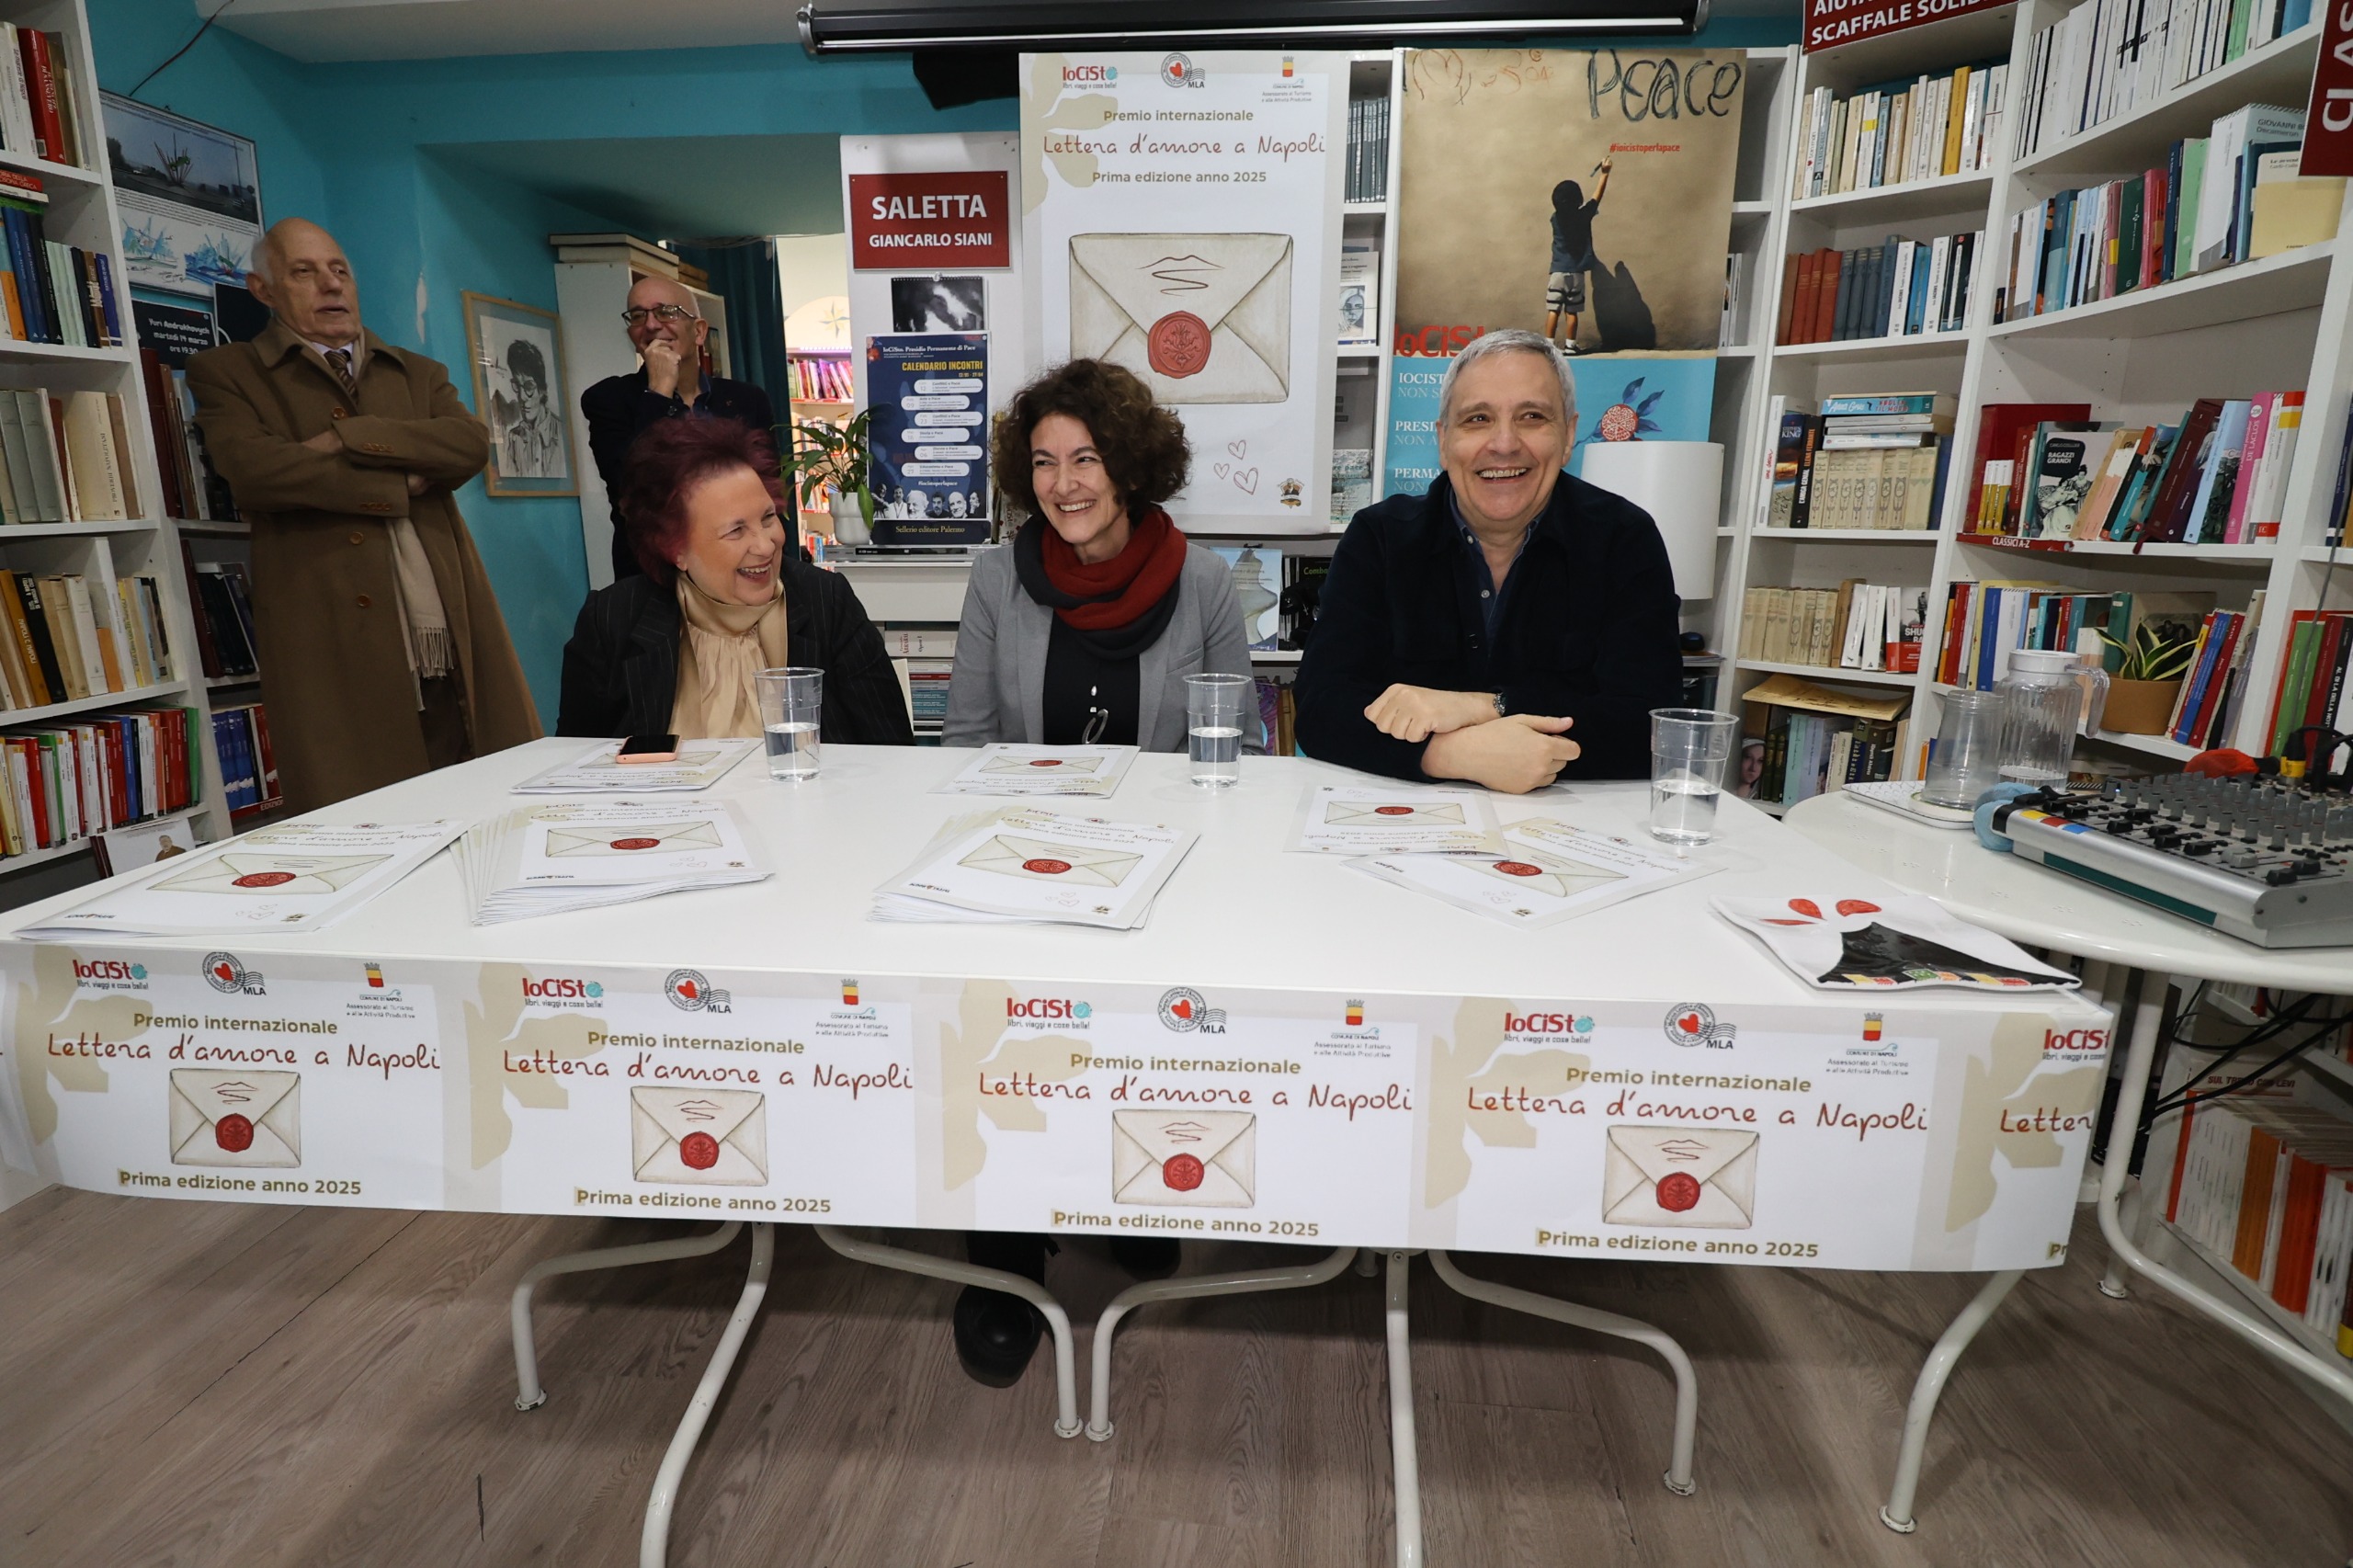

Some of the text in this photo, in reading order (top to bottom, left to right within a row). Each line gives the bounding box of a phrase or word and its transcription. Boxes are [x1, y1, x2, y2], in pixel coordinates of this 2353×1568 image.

[1811, 8, 1911, 45] SCAFFALE
[1586, 50, 1741, 121] Peace
[1104, 110, 1253, 120] Premio internazionale
[1044, 133, 1324, 163] Lettera d'amore a Napoli
[1093, 172, 1266, 182] Prima edizione anno 2025
[872, 195, 987, 220] SALETTA
[870, 233, 992, 247] GIANCARLO SIANI
[902, 361, 983, 371] CALENDARIO INCONTRI
[1398, 387, 1427, 398] NON
[1781, 430, 1802, 438] KING
[1992, 537, 2029, 549] CLASSICI A-Z
[2328, 692, 2336, 711] DELLA
[244, 987, 266, 995] MLA
[708, 1005, 732, 1013] MLA
[134, 1014, 337, 1034] Premio internazionale
[1200, 1025, 1226, 1034] MLA
[588, 1032, 804, 1053] Premio internazionale
[1707, 1039, 1733, 1049] MLA
[49, 1032, 440, 1080] Lettera d'amore a Napoli
[1072, 1054, 1301, 1074] Premio internazionale
[505, 1050, 913, 1100] Lettera d'amore a Napoli
[1567, 1068, 1811, 1092] Premio internazionale
[980, 1072, 1412, 1121] Lettera d'amore a Napoli
[1469, 1086, 1927, 1142] Lettera d'amore a Napoli
[119, 1171, 360, 1194] Prima edizione anno 2025
[577, 1190, 830, 1212] Prima edizione anno 2025
[1054, 1211, 1318, 1236] Prima edizione anno 2025
[1539, 1231, 1818, 1257] Prima edizione anno 2025
